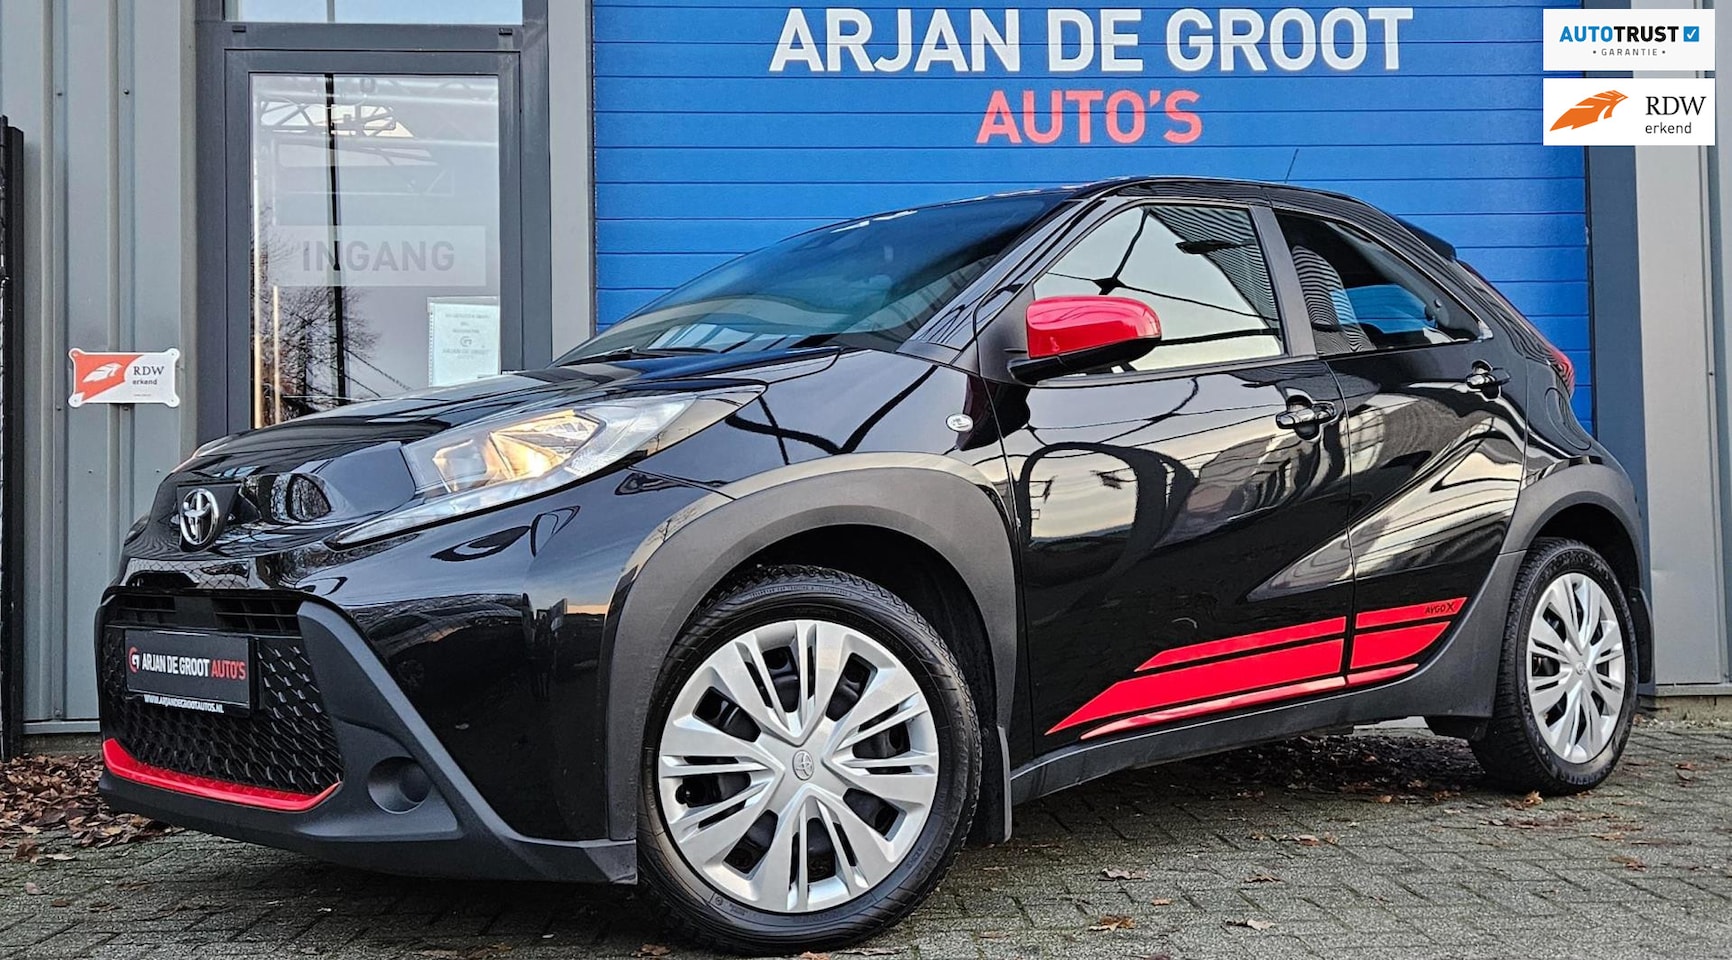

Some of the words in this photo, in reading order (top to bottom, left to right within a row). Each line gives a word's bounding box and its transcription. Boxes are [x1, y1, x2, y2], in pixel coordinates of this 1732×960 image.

[769, 8, 1020, 72] ARJAN
[1048, 8, 1144, 72] DE
[1169, 7, 1413, 71] GROOT
[976, 89, 1204, 145] AUTO'S
[302, 240, 455, 272] INGANG
[133, 366, 165, 376] RDW
[142, 653, 166, 673] ARJAN
[167, 656, 179, 674] DE
[179, 658, 210, 677] GROOT
[211, 660, 247, 680] AUTO'S
